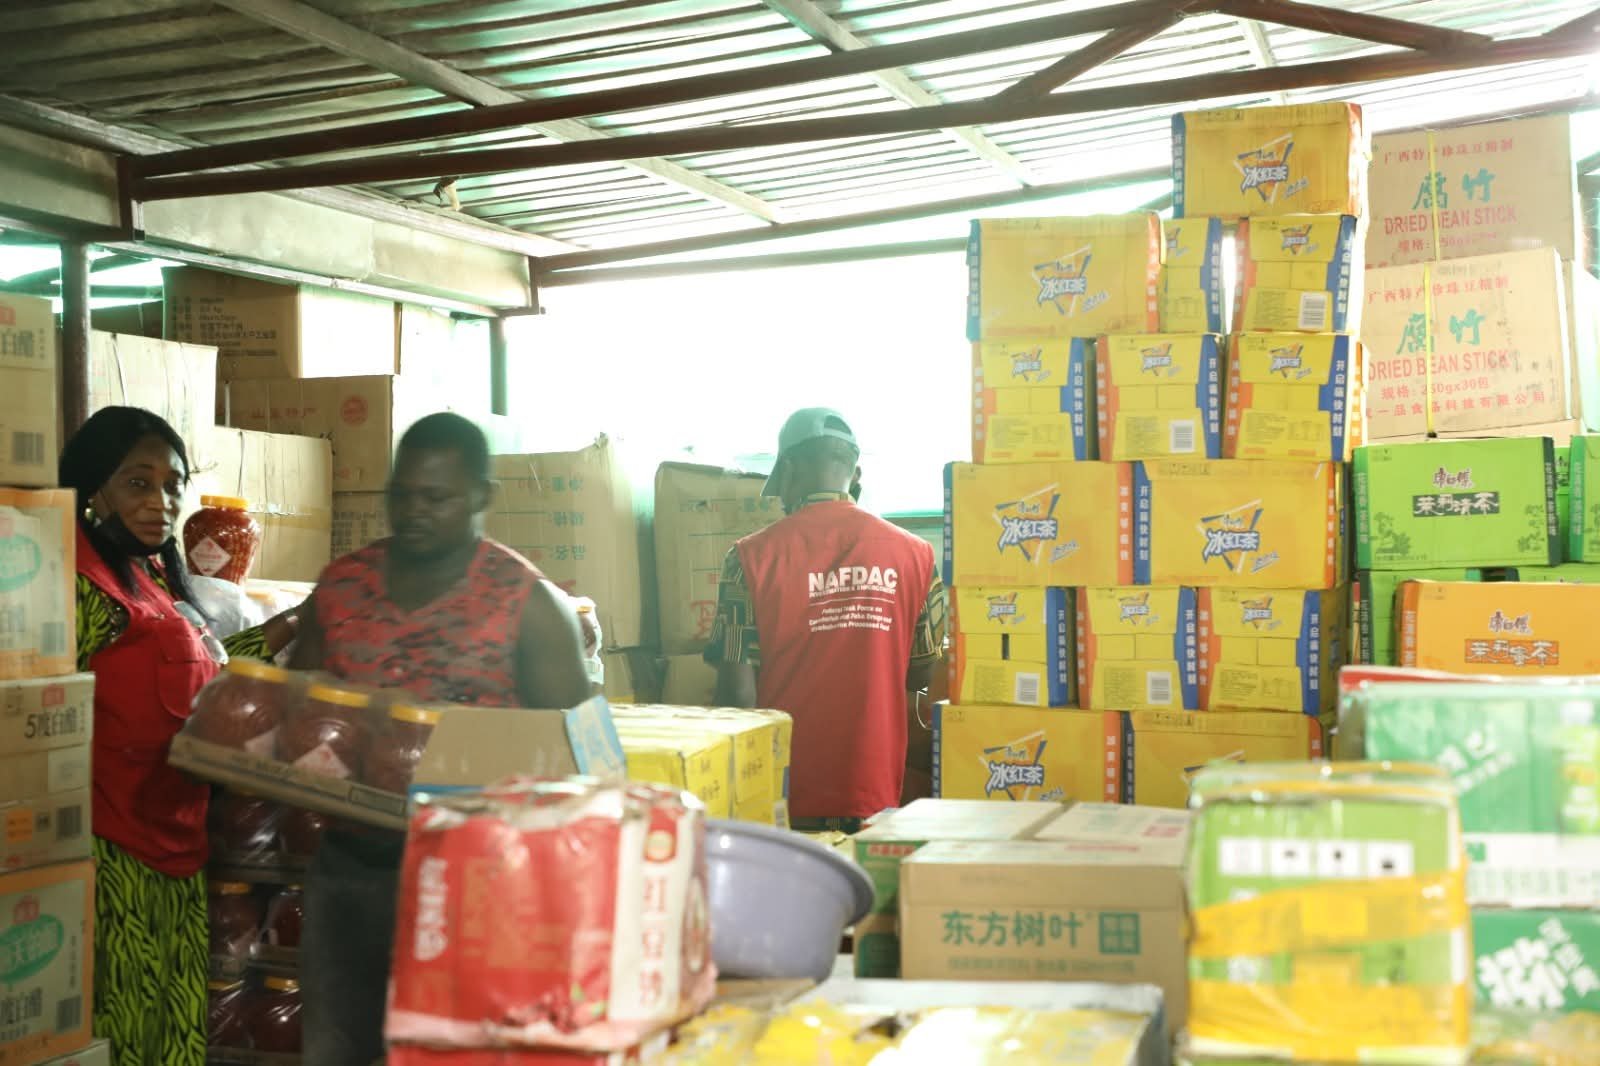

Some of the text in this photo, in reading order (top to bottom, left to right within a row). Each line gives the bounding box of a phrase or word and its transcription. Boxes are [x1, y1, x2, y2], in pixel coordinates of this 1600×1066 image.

[1241, 165, 1289, 193] 冰红茶
[1384, 205, 1518, 235] DRIED EAN STICK
[1368, 350, 1510, 381] DRIED BEAN STICK
[1414, 492, 1499, 517] 茉莉清茶
[997, 517, 1058, 553] 冰红茶
[1203, 529, 1260, 563] 冰红茶
[808, 566, 898, 592] NAFDAC
[1466, 640, 1559, 666] 茉莉蜜茶
[986, 761, 1045, 796] 冰红茶
[941, 910, 1083, 948] 东方树叶
